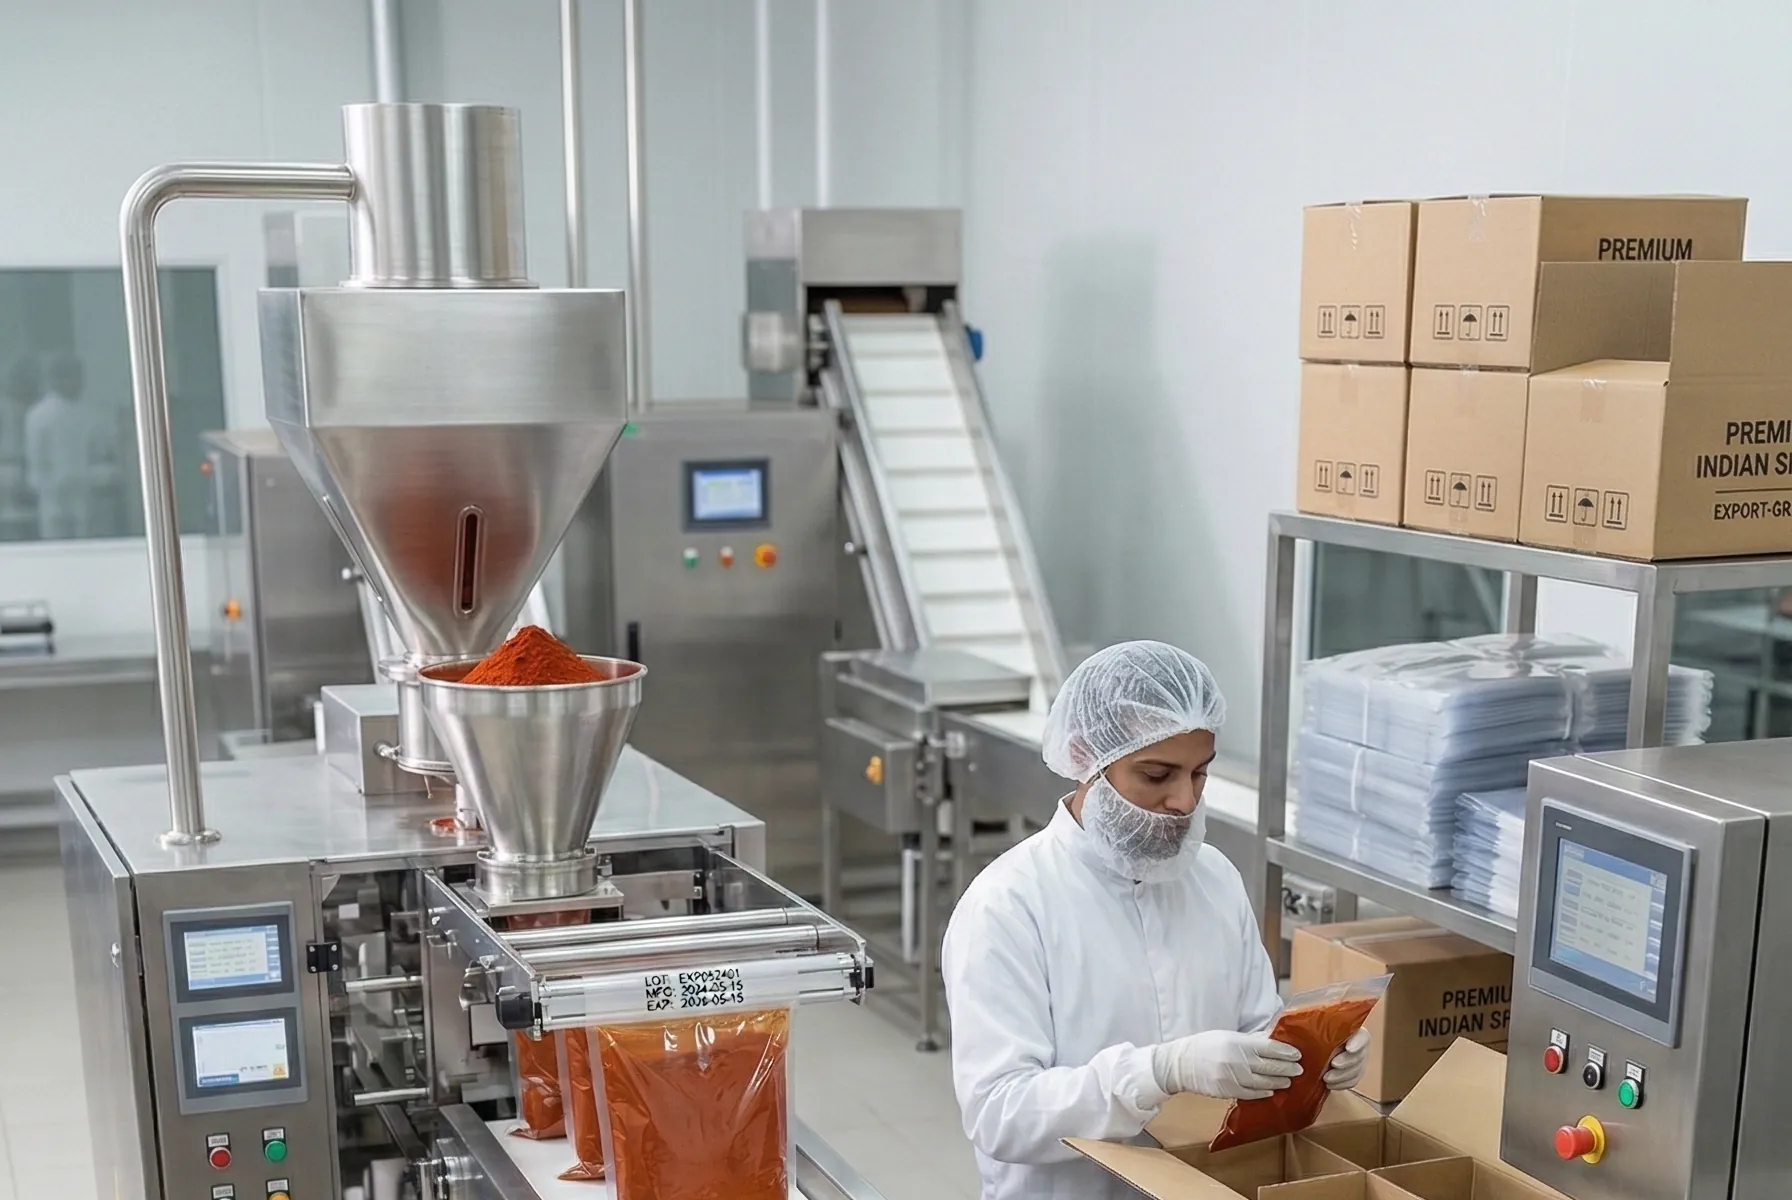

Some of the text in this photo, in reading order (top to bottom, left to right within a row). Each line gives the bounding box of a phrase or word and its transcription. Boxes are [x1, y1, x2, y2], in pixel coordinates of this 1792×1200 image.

[1598, 238, 1693, 261] PREMIUM
[1725, 420, 1792, 446] PREMI
[1696, 453, 1769, 478] INDIAN
[1713, 501, 1792, 520] EXPORT-GR
[1442, 985, 1512, 1009] PREMIU
[1418, 1012, 1484, 1038] INDIAN
